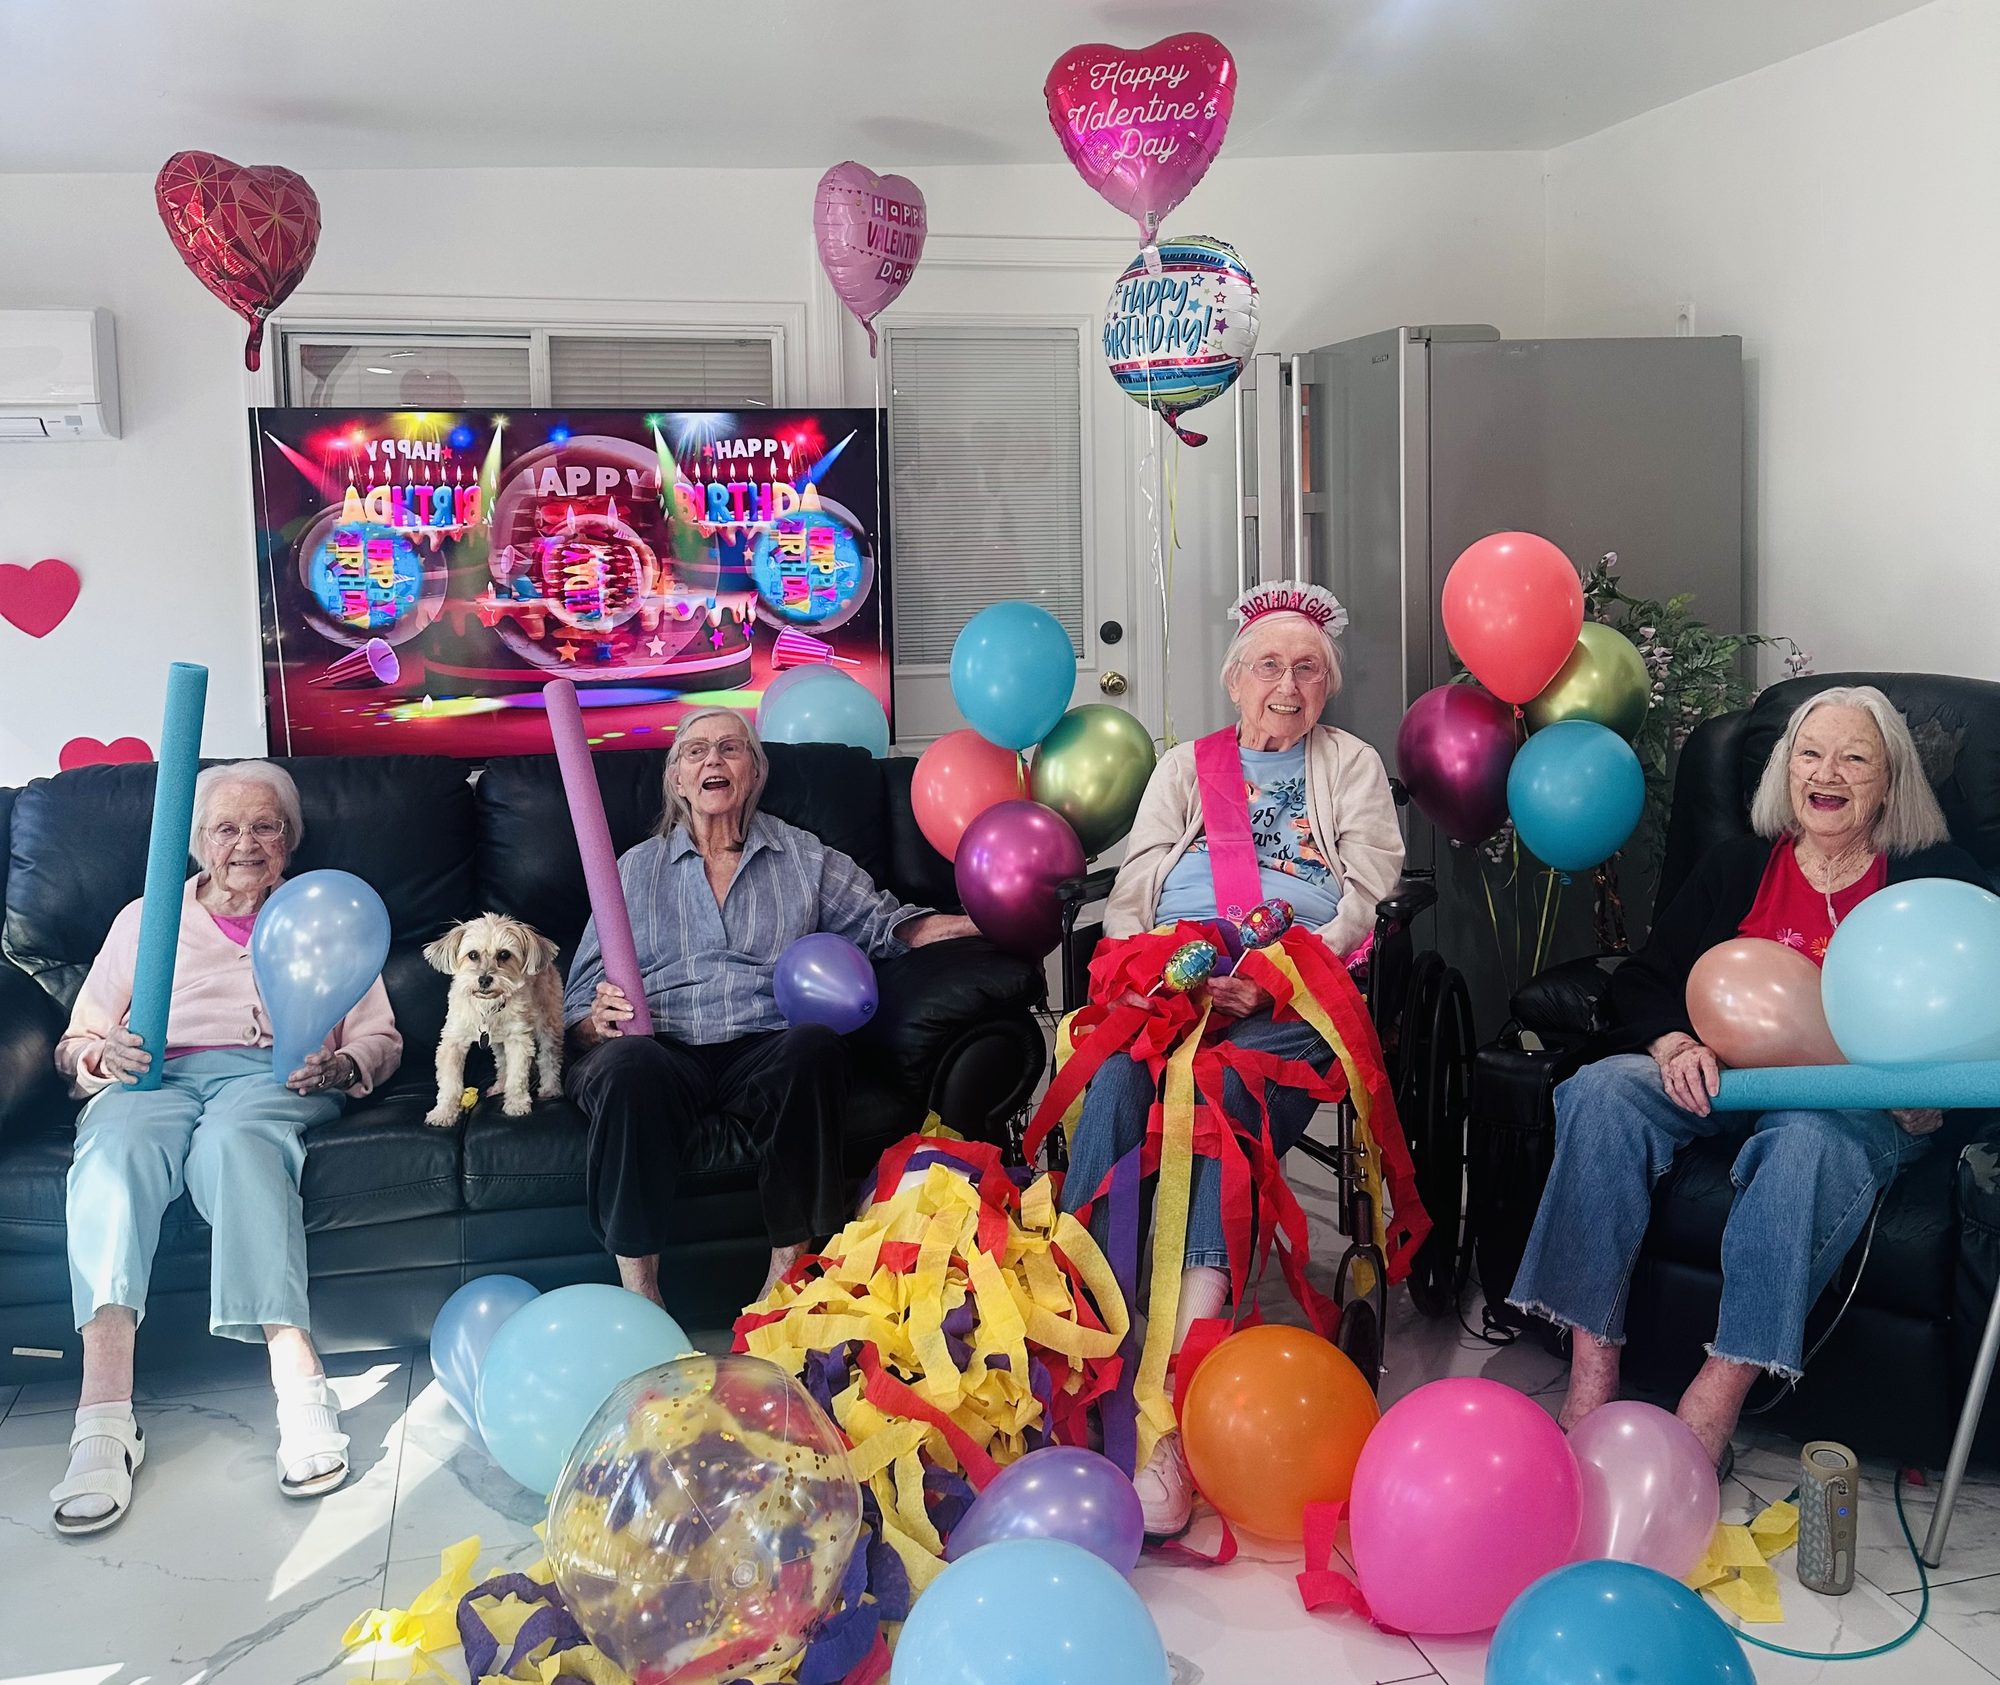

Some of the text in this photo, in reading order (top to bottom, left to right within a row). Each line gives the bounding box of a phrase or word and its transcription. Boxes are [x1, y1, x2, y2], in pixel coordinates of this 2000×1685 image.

[1089, 60, 1190, 95] Happy
[1067, 92, 1218, 135] Valentine's
[1112, 128, 1180, 163] Day
[867, 221, 920, 259] VALENTIN
[1121, 278, 1189, 317] HAPPY
[1102, 305, 1213, 360] BIRTHDAY!
[716, 438, 795, 460] HAPPY
[673, 481, 823, 523] BIRTHDA
[367, 539, 396, 617] HAPPY
[808, 527, 838, 602] HAPPY
[1240, 590, 1337, 627] BIRTHDAY GIRL
[1252, 831, 1282, 847] ars
